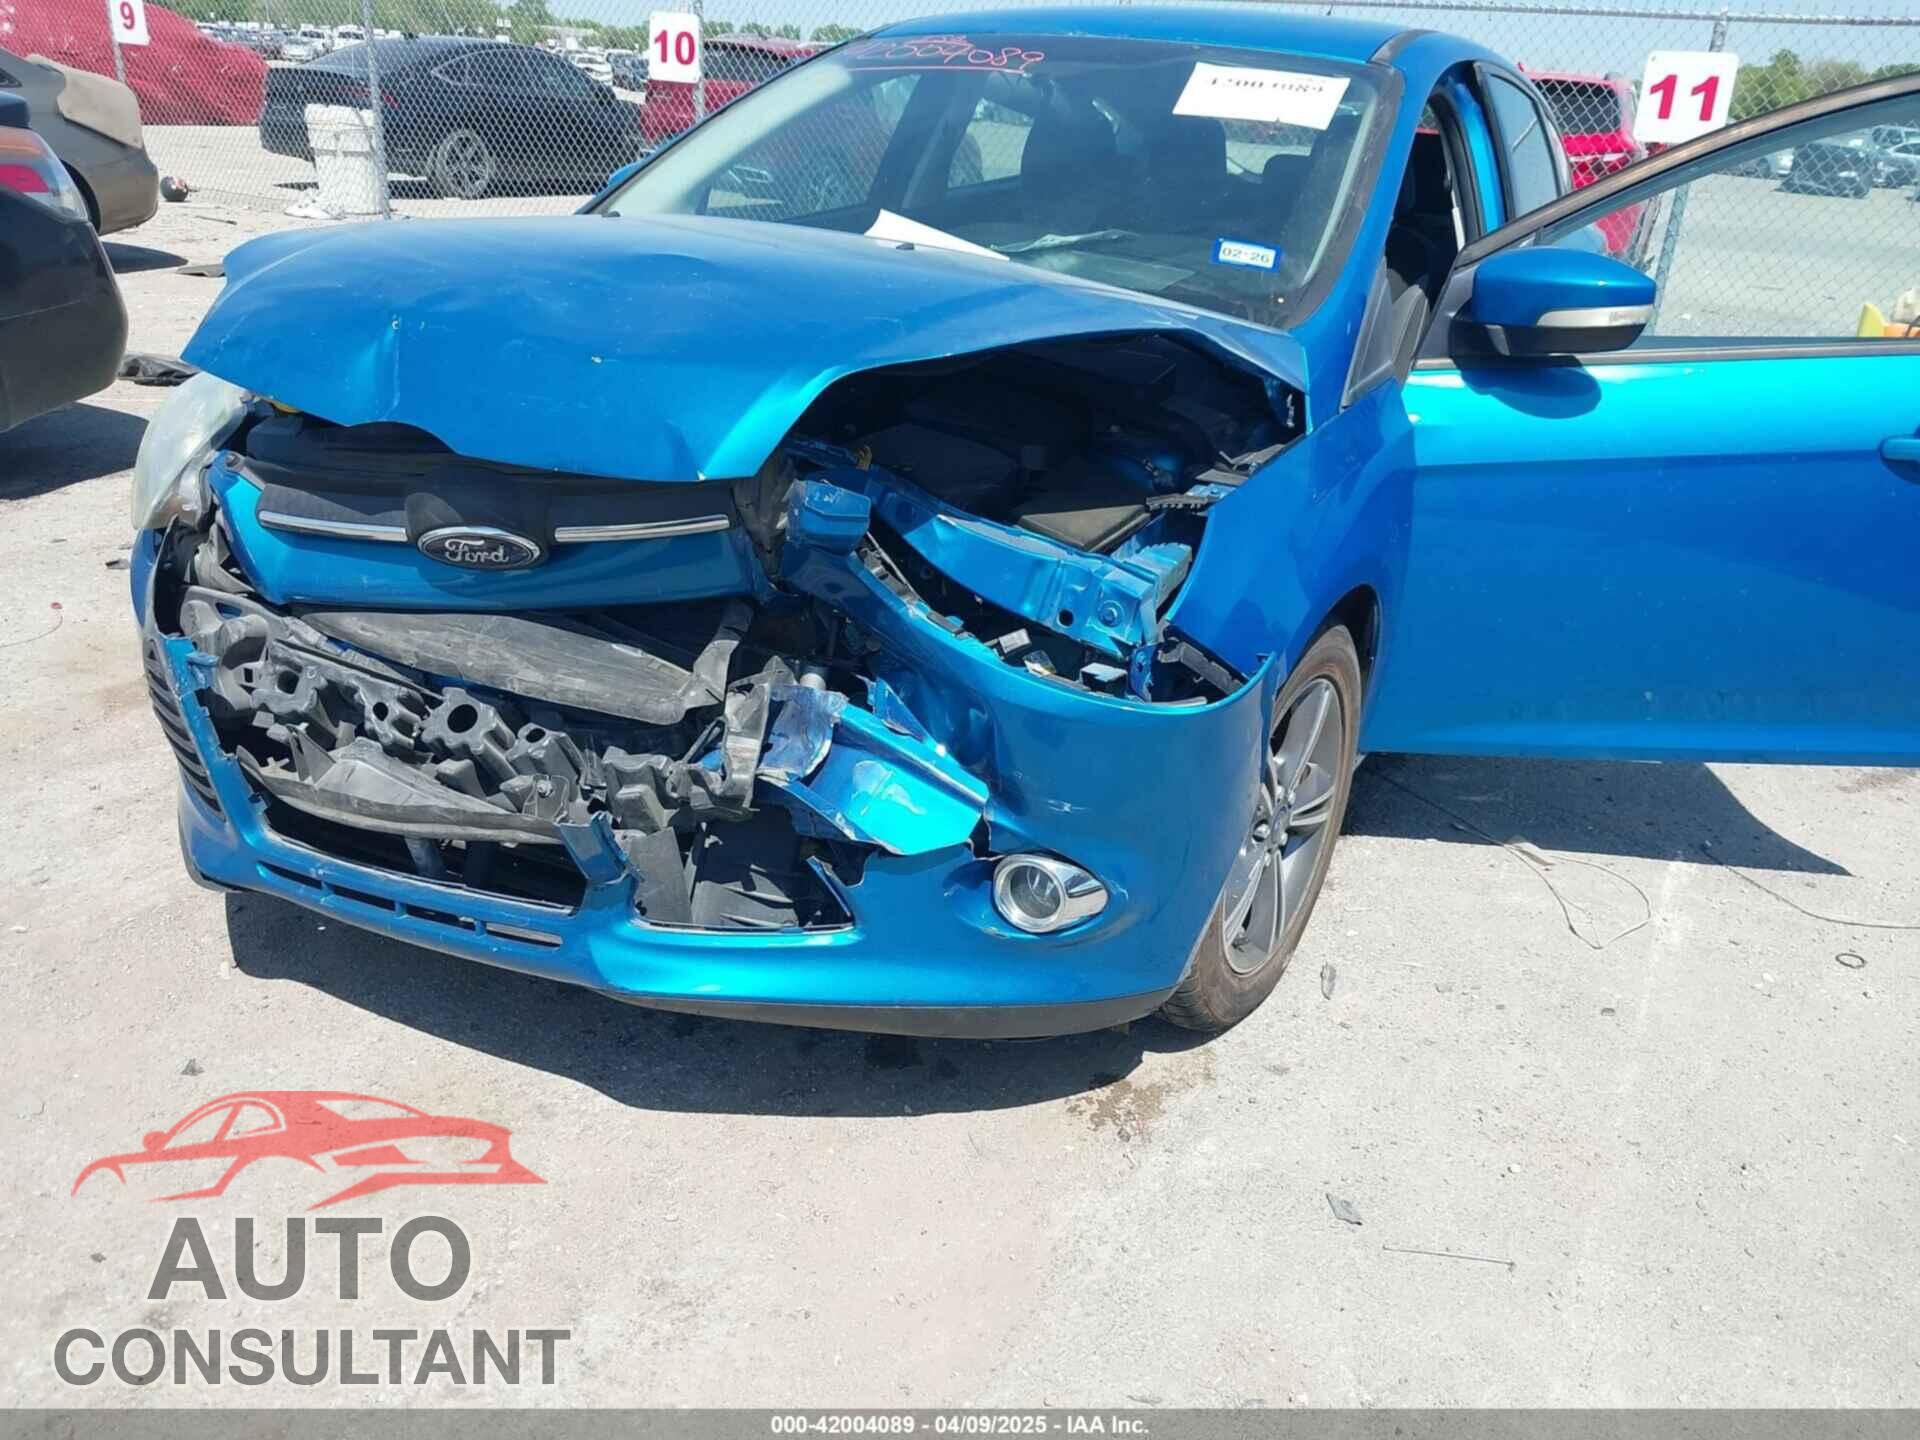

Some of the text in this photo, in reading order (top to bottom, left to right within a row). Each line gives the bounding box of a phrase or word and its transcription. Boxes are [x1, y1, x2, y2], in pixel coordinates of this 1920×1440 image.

[120, 1, 135, 30] 9
[654, 29, 695, 65] 10
[1649, 73, 1720, 122] 11
[444, 538, 509, 562] Ford
